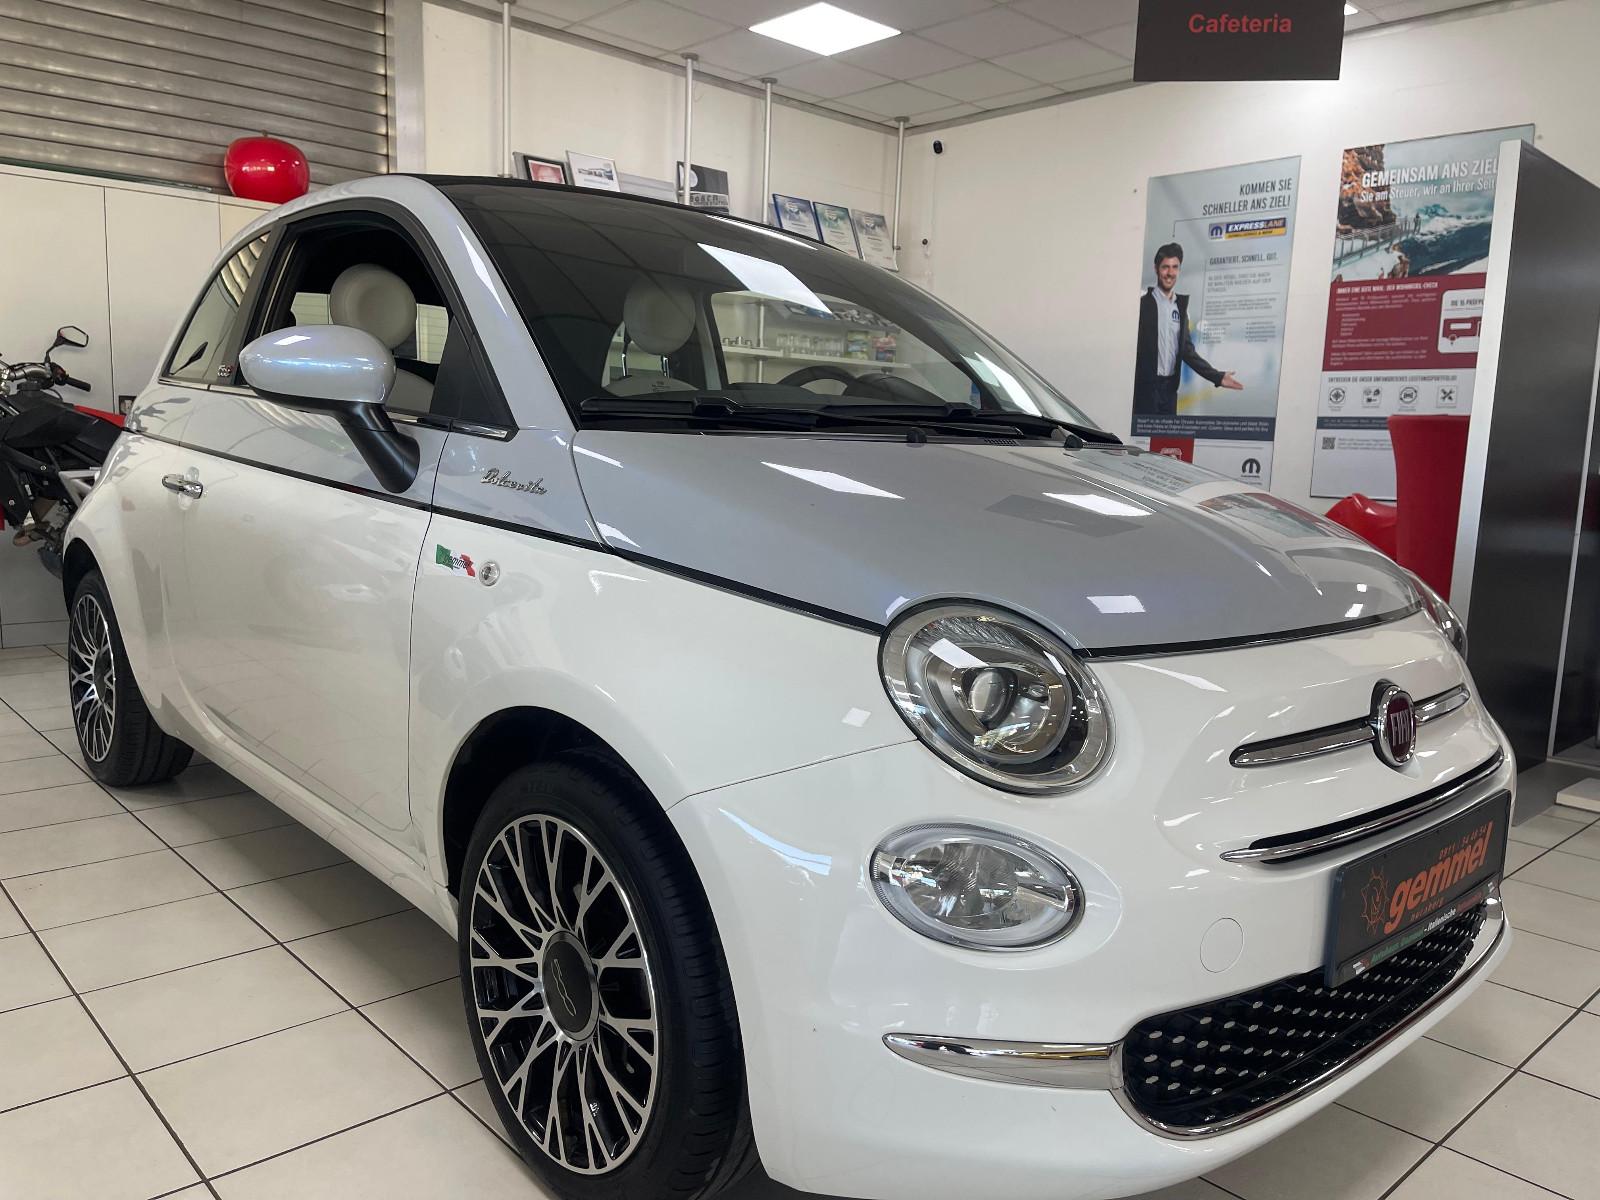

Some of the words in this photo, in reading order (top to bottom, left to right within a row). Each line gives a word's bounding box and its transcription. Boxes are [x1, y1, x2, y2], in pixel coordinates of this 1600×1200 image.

[1188, 13, 1292, 33] Cafeteria
[1362, 164, 1438, 188] GEMEINSAM
[1441, 161, 1468, 179] ANS
[1240, 180, 1276, 196] KOMMEN
[1279, 178, 1292, 191] SIE
[1360, 190, 1374, 202] Sie
[1375, 191, 1389, 201] am
[1389, 186, 1420, 200] Steuer,
[1423, 184, 1437, 196] wir
[1440, 184, 1450, 193] an
[1453, 180, 1474, 192] Ihrer
[1477, 178, 1495, 191] Seit
[1202, 200, 1248, 216] SCHNELLER
[1250, 198, 1267, 211] ANS
[1270, 195, 1291, 209] ZIEL!
[1383, 821, 1493, 935] gemmel
